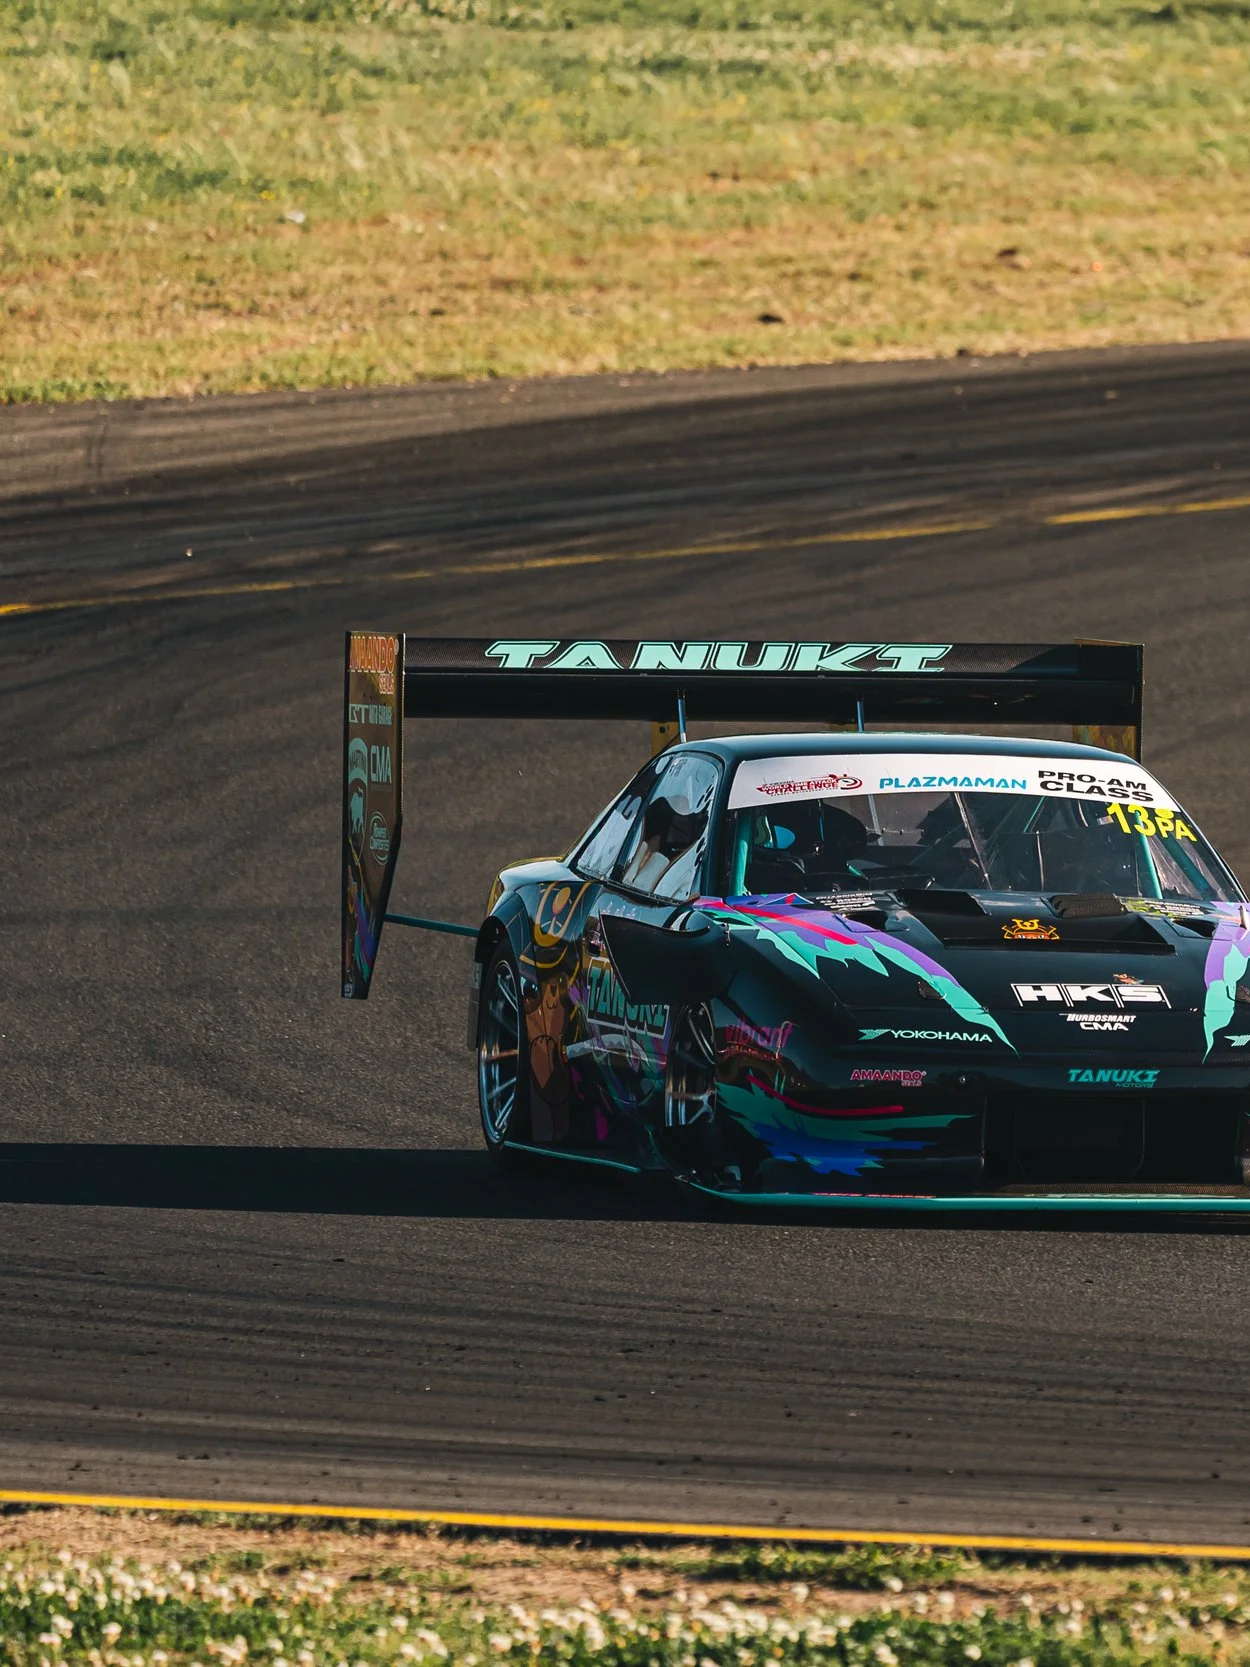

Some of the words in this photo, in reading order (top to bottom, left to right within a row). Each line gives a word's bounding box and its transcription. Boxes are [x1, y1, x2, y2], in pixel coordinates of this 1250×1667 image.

[484, 640, 954, 673] TANUKI
[371, 745, 393, 783] CMA
[880, 777, 1026, 789] PLAZMAMAN
[1038, 770, 1147, 791] PRO-AM
[1040, 780, 1154, 802] CLASS
[1012, 984, 1168, 1005] HKS
[1079, 1022, 1129, 1031] CMA
[890, 1030, 993, 1042] YOKOHAMA
[850, 1069, 923, 1081] AMAANDO
[1068, 1069, 1160, 1083] TANUKI
